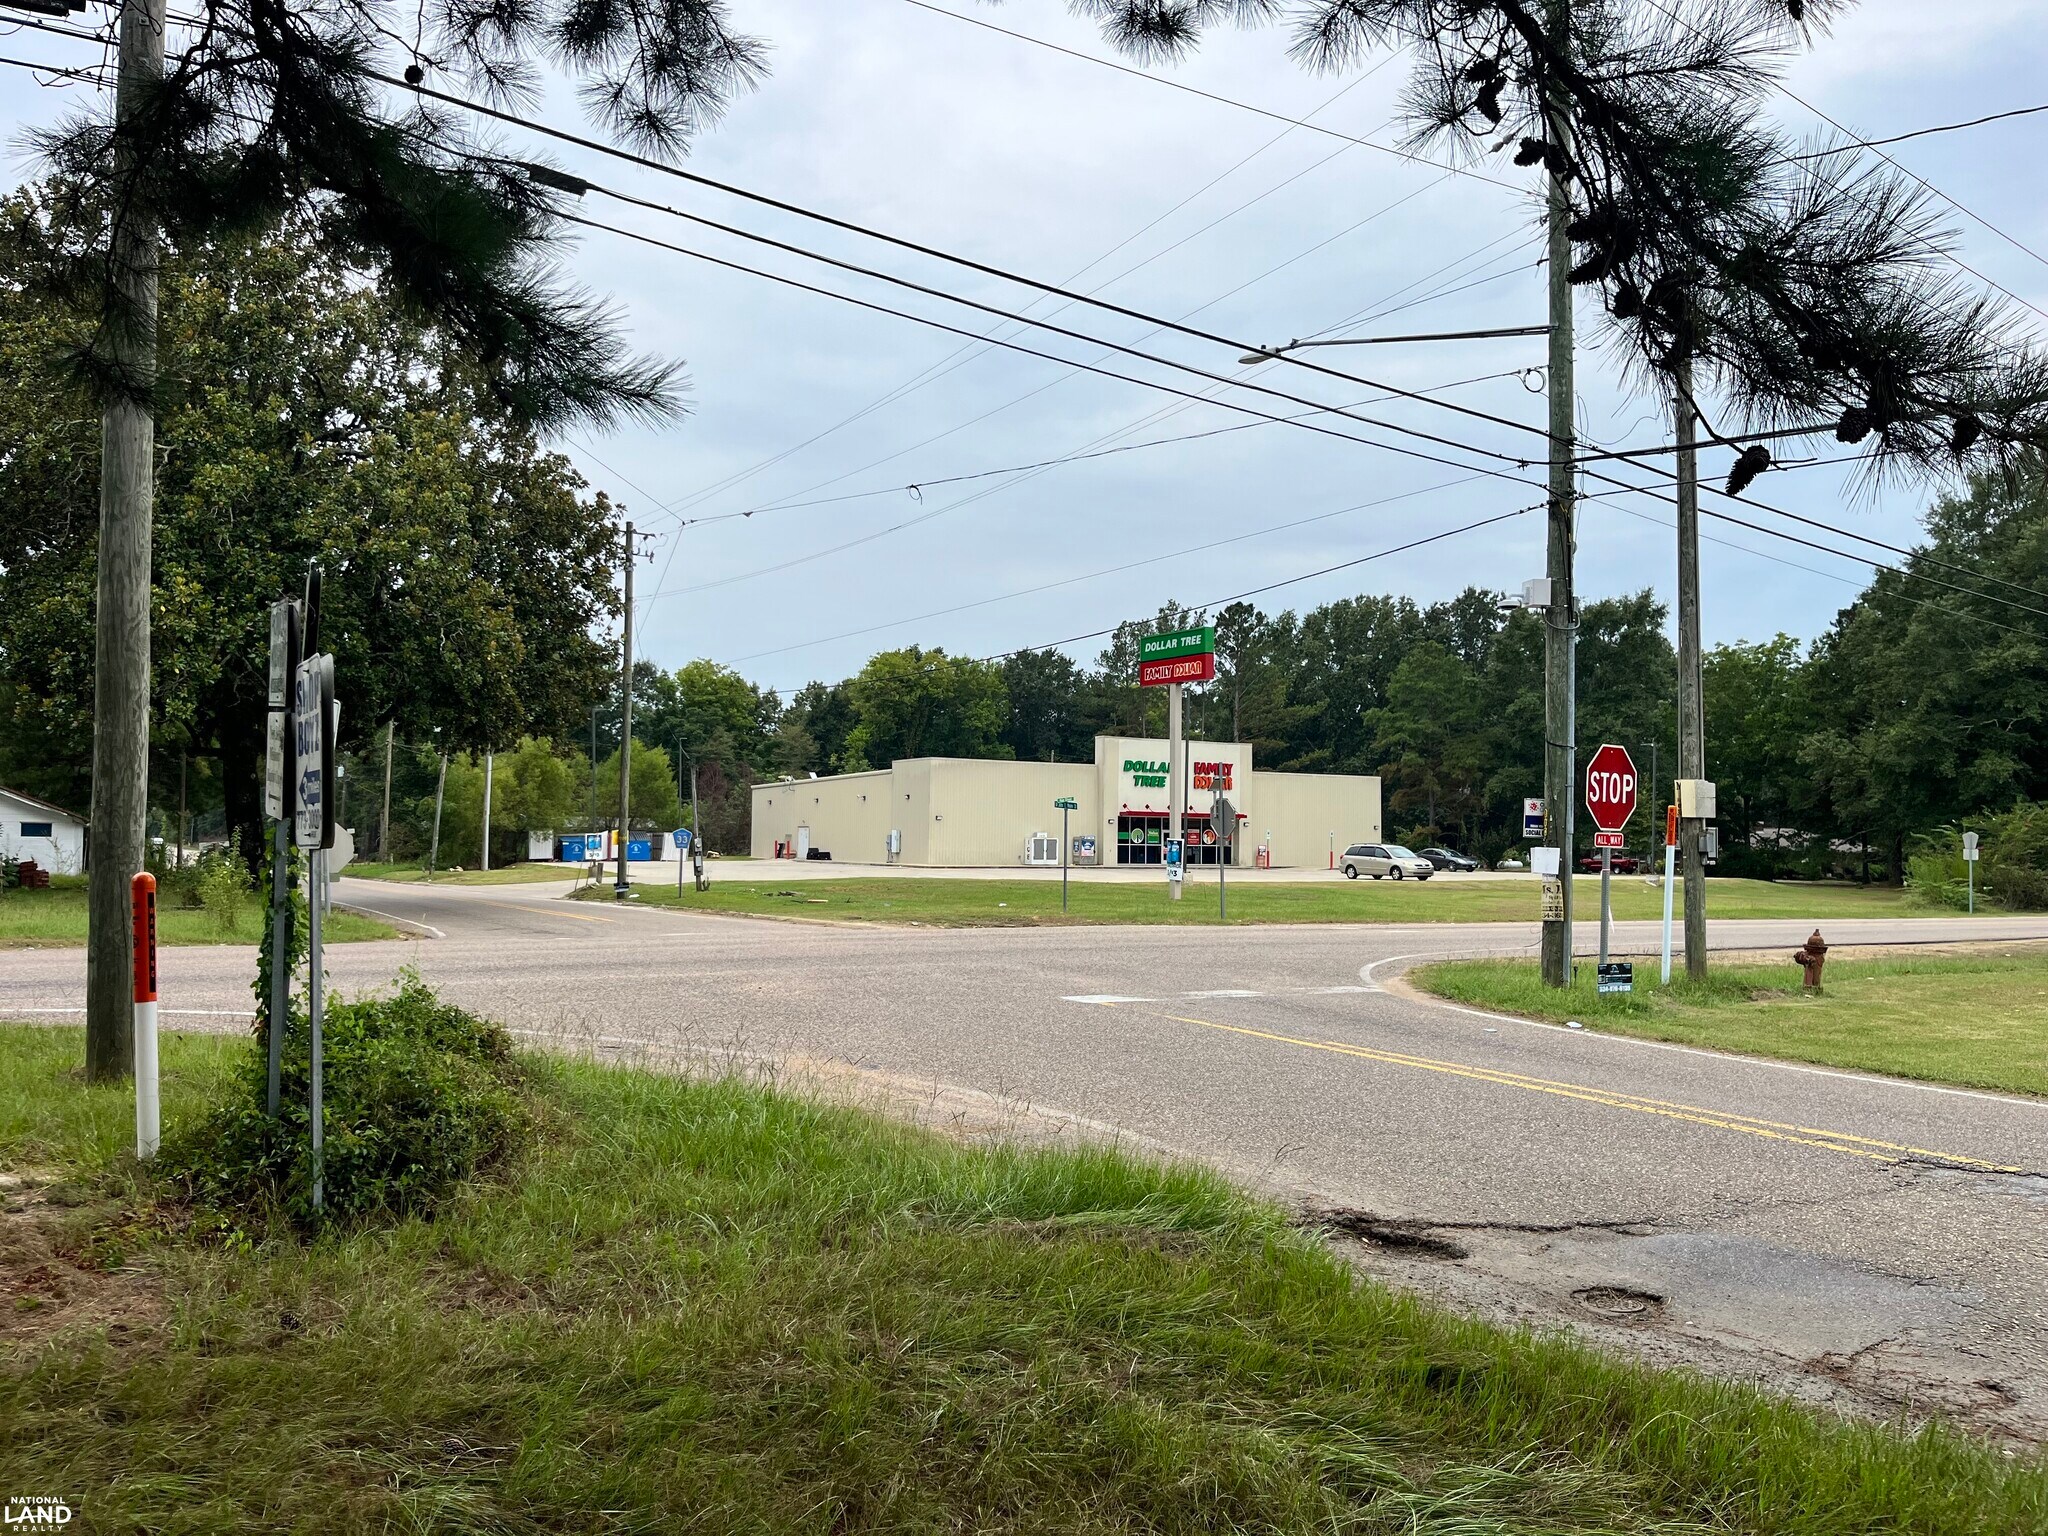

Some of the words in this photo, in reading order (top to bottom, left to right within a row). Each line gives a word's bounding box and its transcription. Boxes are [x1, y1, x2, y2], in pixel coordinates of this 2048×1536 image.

[1144, 638, 1178, 653] DOLLAR
[1180, 634, 1202, 647] TREE
[1144, 664, 1173, 681] FAMILY
[1173, 660, 1202, 678] DOLLAR
[296, 670, 320, 717] SHOP
[297, 712, 320, 757] BOYZ
[1194, 762, 1233, 776] FAMLY
[1133, 774, 1167, 788] TREE
[1589, 770, 1634, 804] STOP
[676, 835, 688, 844] 33
[1597, 835, 1608, 845] ALL
[1609, 836, 1621, 845] WAY
